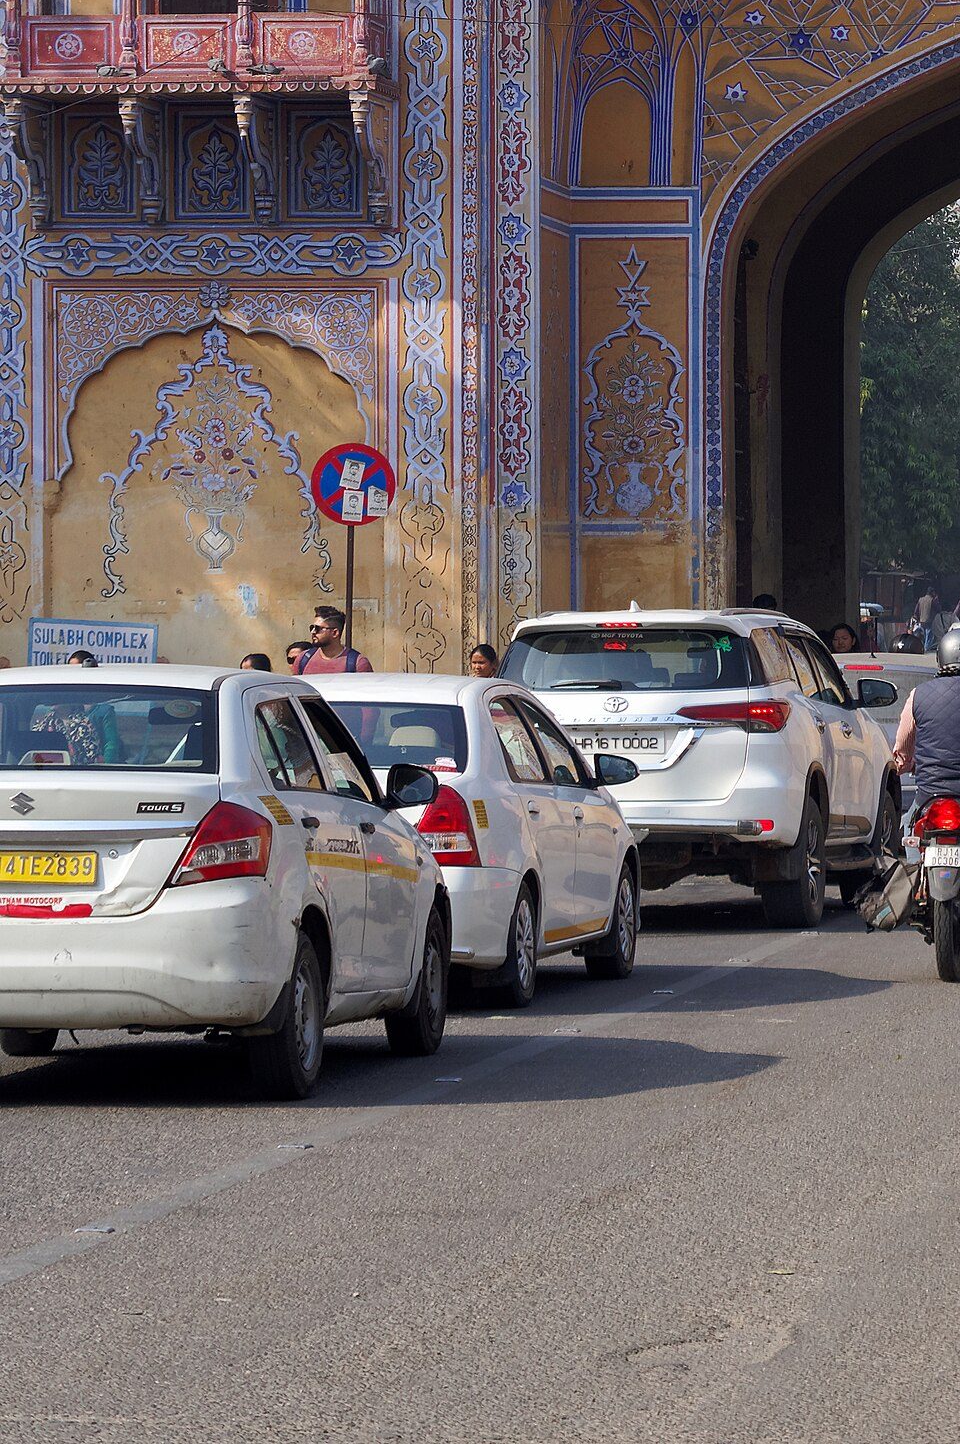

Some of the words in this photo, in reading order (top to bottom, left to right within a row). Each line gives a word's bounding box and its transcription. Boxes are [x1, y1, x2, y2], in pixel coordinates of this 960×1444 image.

[34, 627, 84, 646] SULABH
[87, 630, 148, 649] COMPLEX
[622, 737, 658, 749] 0002
[170, 804, 182, 812] S
[937, 847, 959, 857] RJ14
[0, 856, 92, 876] 4TE2839
[24, 897, 63, 905] MOTOCORP
